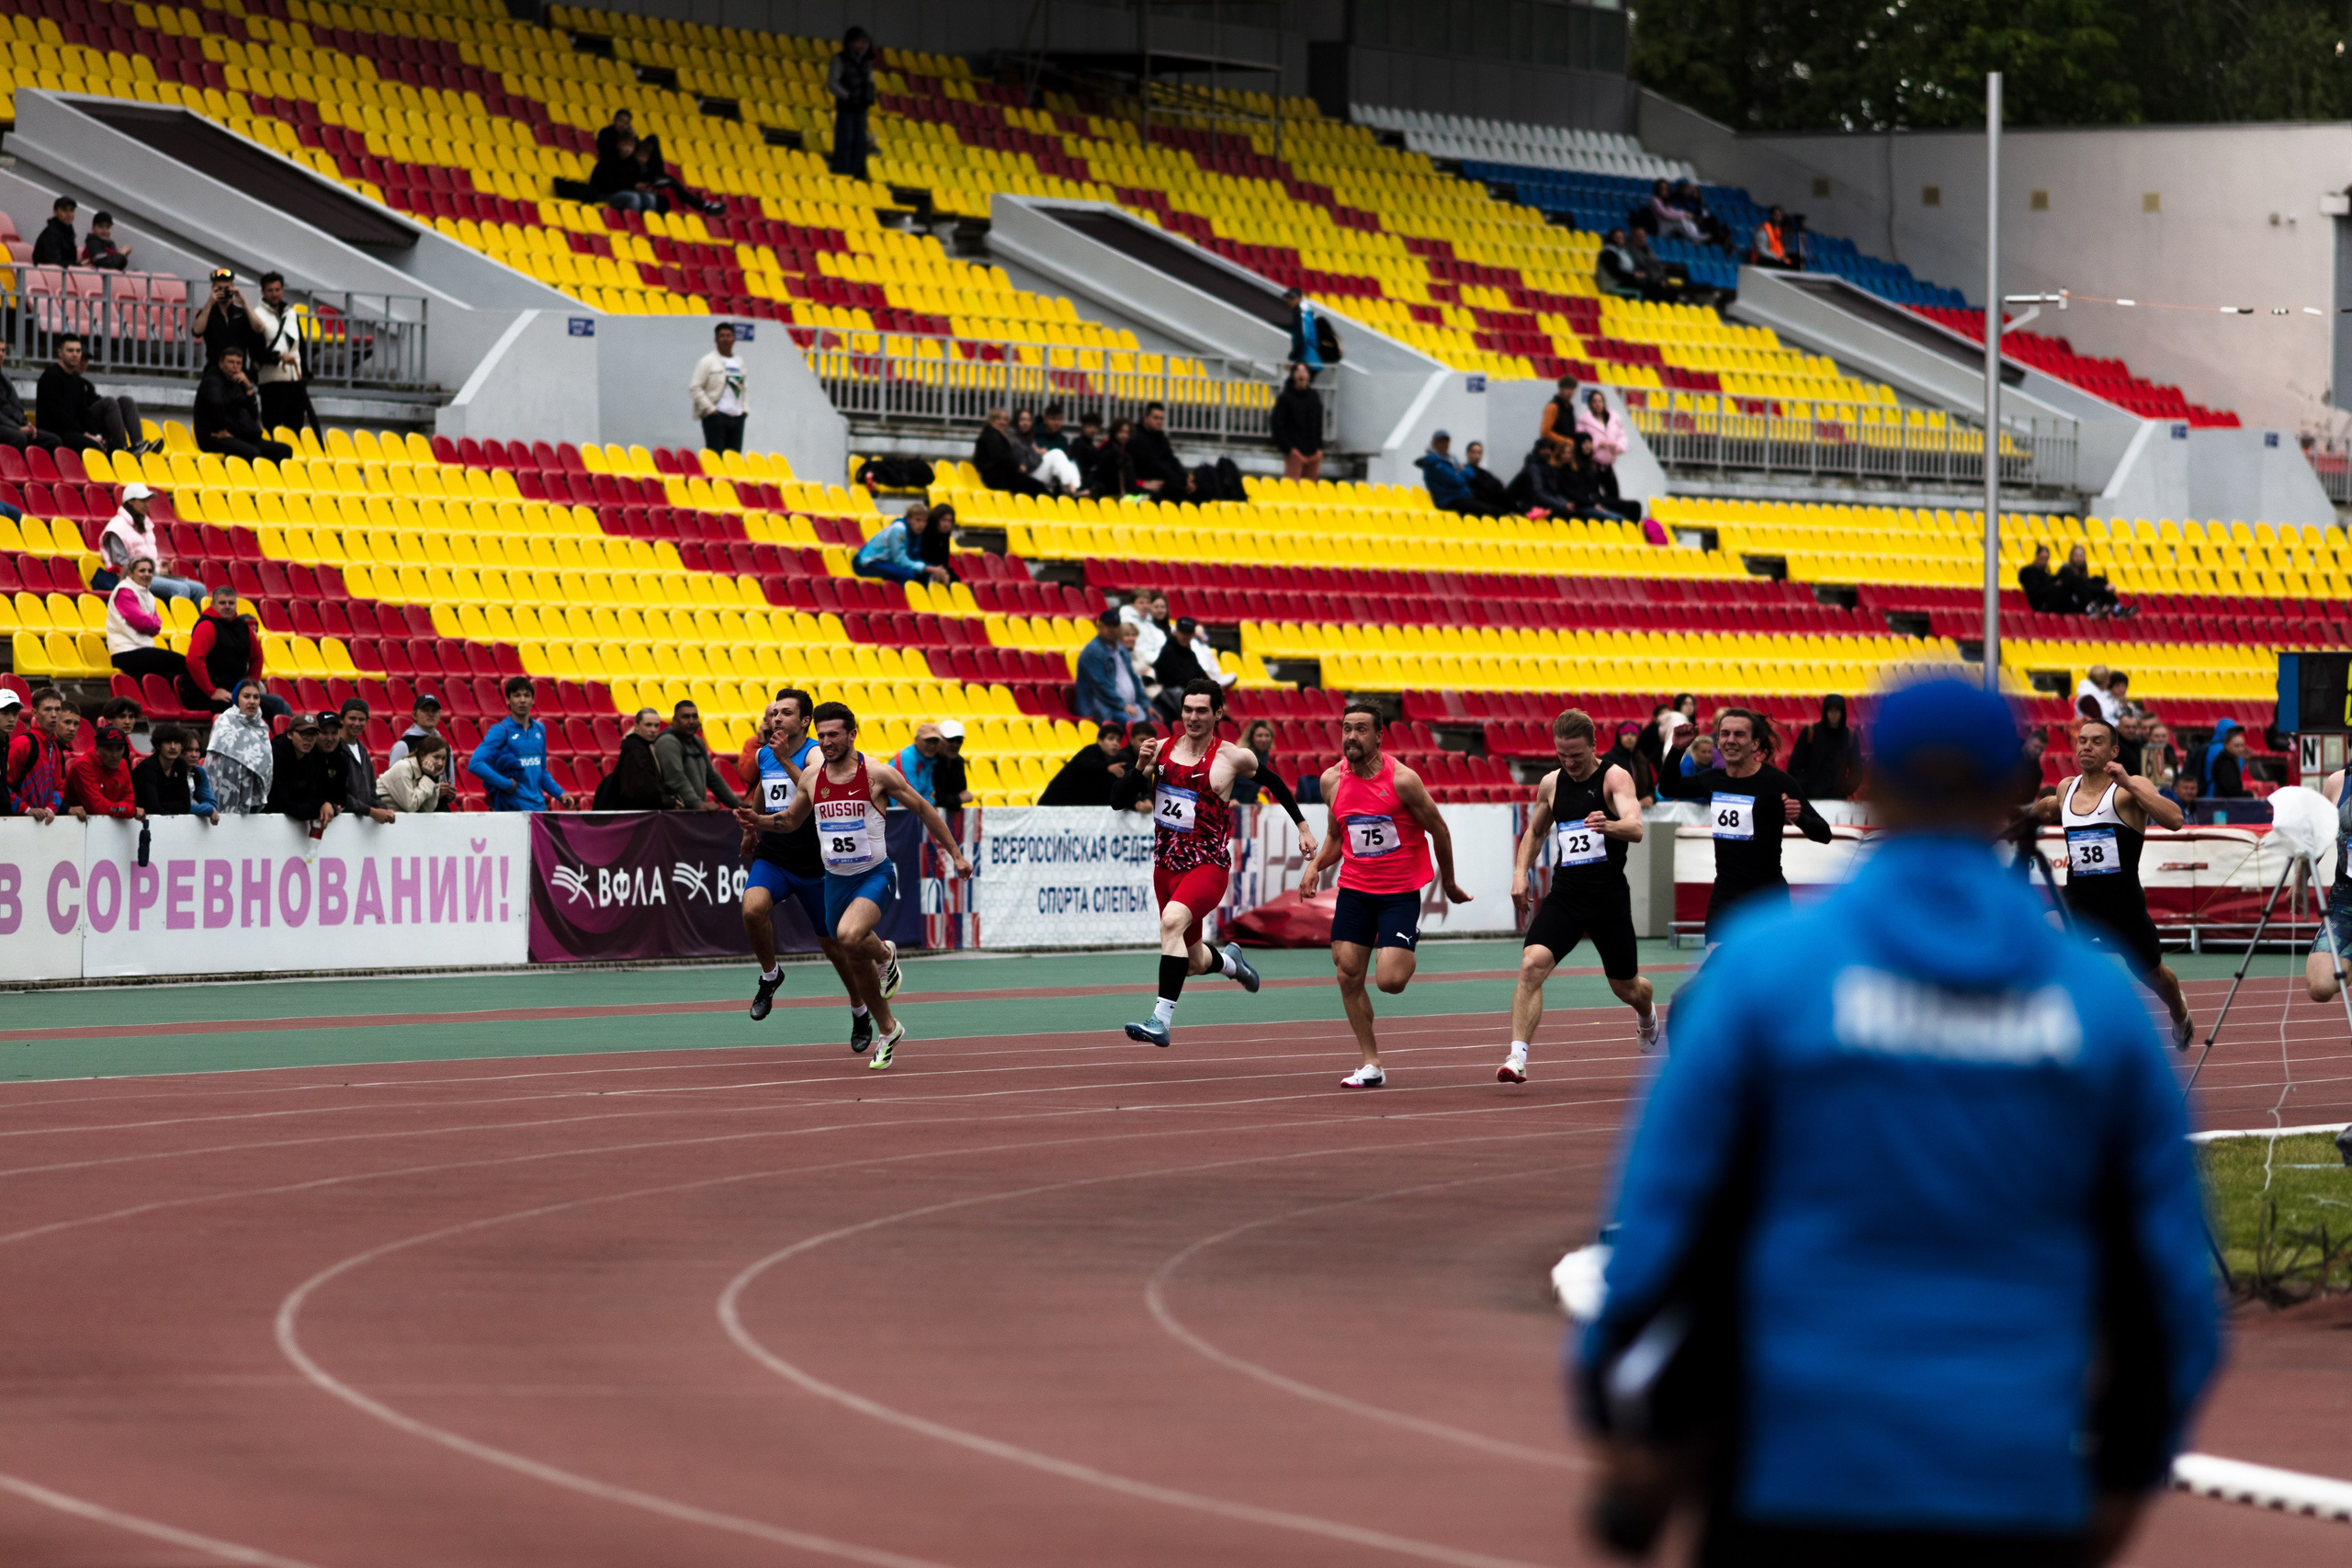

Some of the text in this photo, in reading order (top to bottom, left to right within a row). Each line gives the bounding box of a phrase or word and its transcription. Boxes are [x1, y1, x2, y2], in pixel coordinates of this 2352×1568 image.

[770, 784, 787, 801] 67
[819, 802, 865, 819] RUSSIA
[1161, 798, 1182, 819] 24
[1717, 809, 1739, 828] 68
[832, 837, 856, 852] 85
[1361, 829, 1384, 846] 75
[1569, 835, 1591, 853] 23
[991, 829, 1156, 867] ВСЕРОССИЙСКАЯ ФЕДЕР
[2080, 845, 2105, 864] 38
[46, 837, 510, 935] СОРЕВНОВАНИЙ!
[598, 866, 666, 908] ВФЛА
[718, 864, 749, 904] ВФ
[1038, 886, 1148, 915] СПОРТА СЛЕПЫХ
